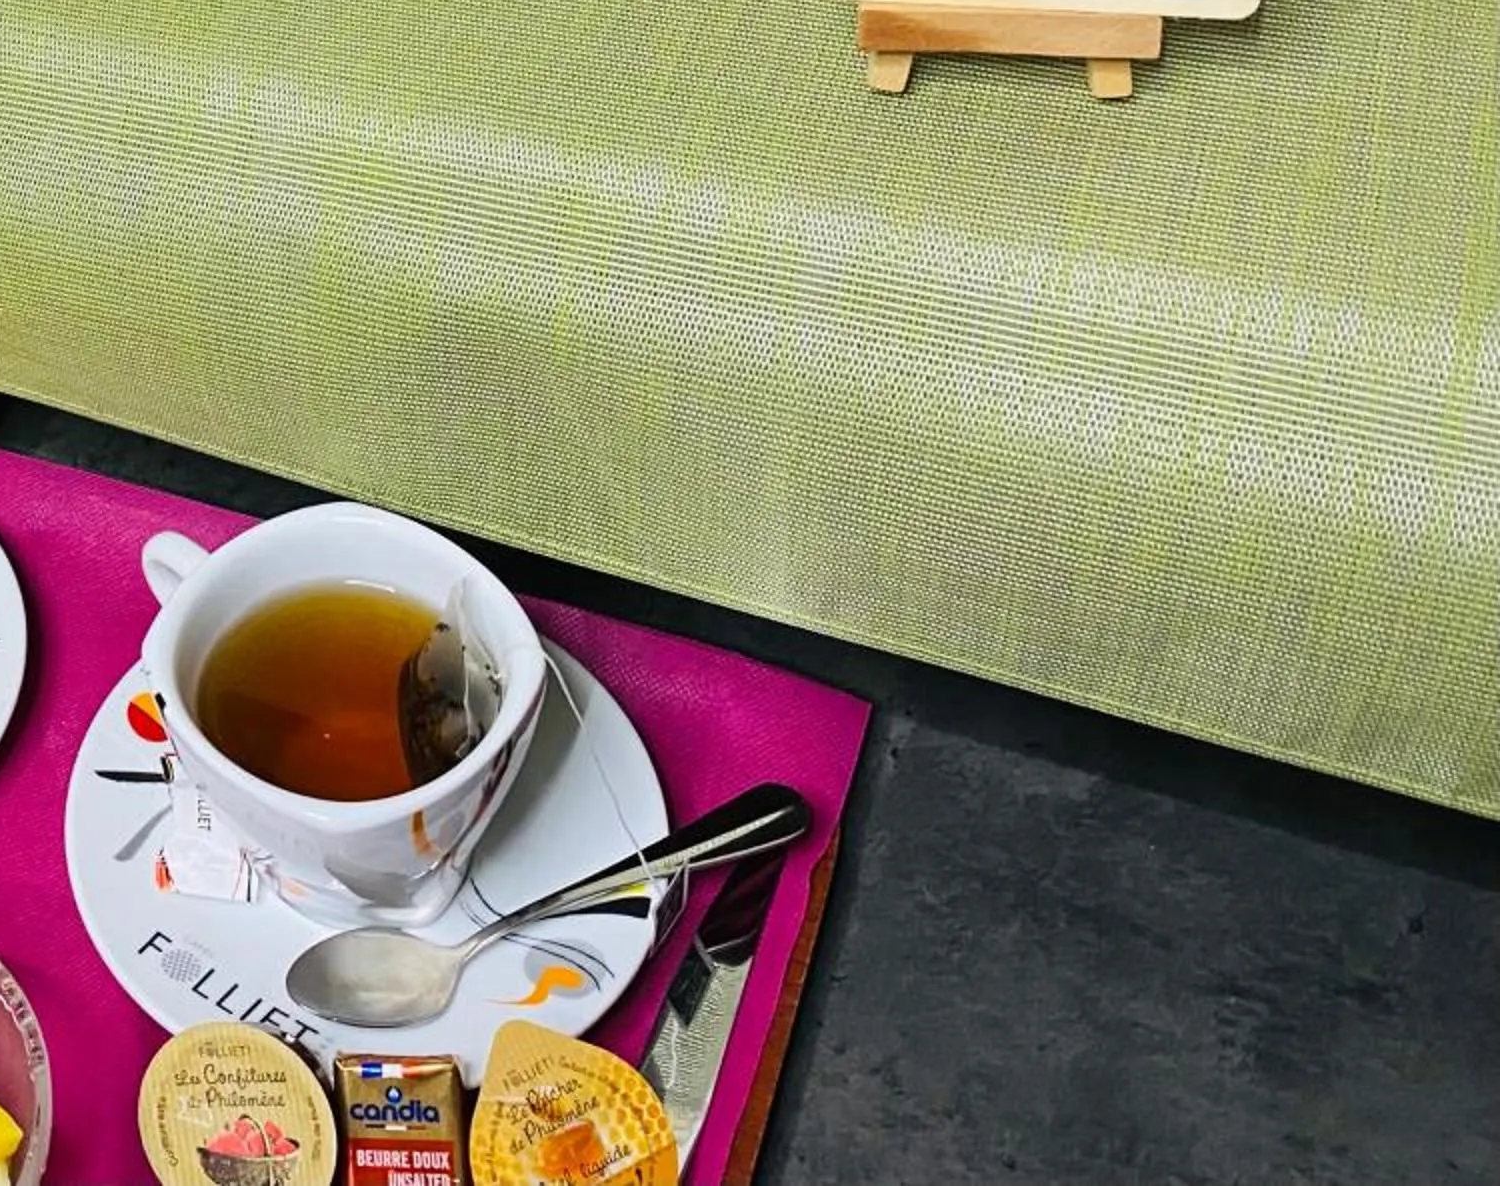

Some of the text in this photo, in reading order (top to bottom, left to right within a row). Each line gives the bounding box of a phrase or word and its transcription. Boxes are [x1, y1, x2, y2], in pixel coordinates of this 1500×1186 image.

[174, 1063, 287, 1090] Les Confitures
[349, 1099, 441, 1123] candia
[356, 1149, 451, 1169] BEURRE DOUX
[387, 1169, 451, 1186] UNSALTED
